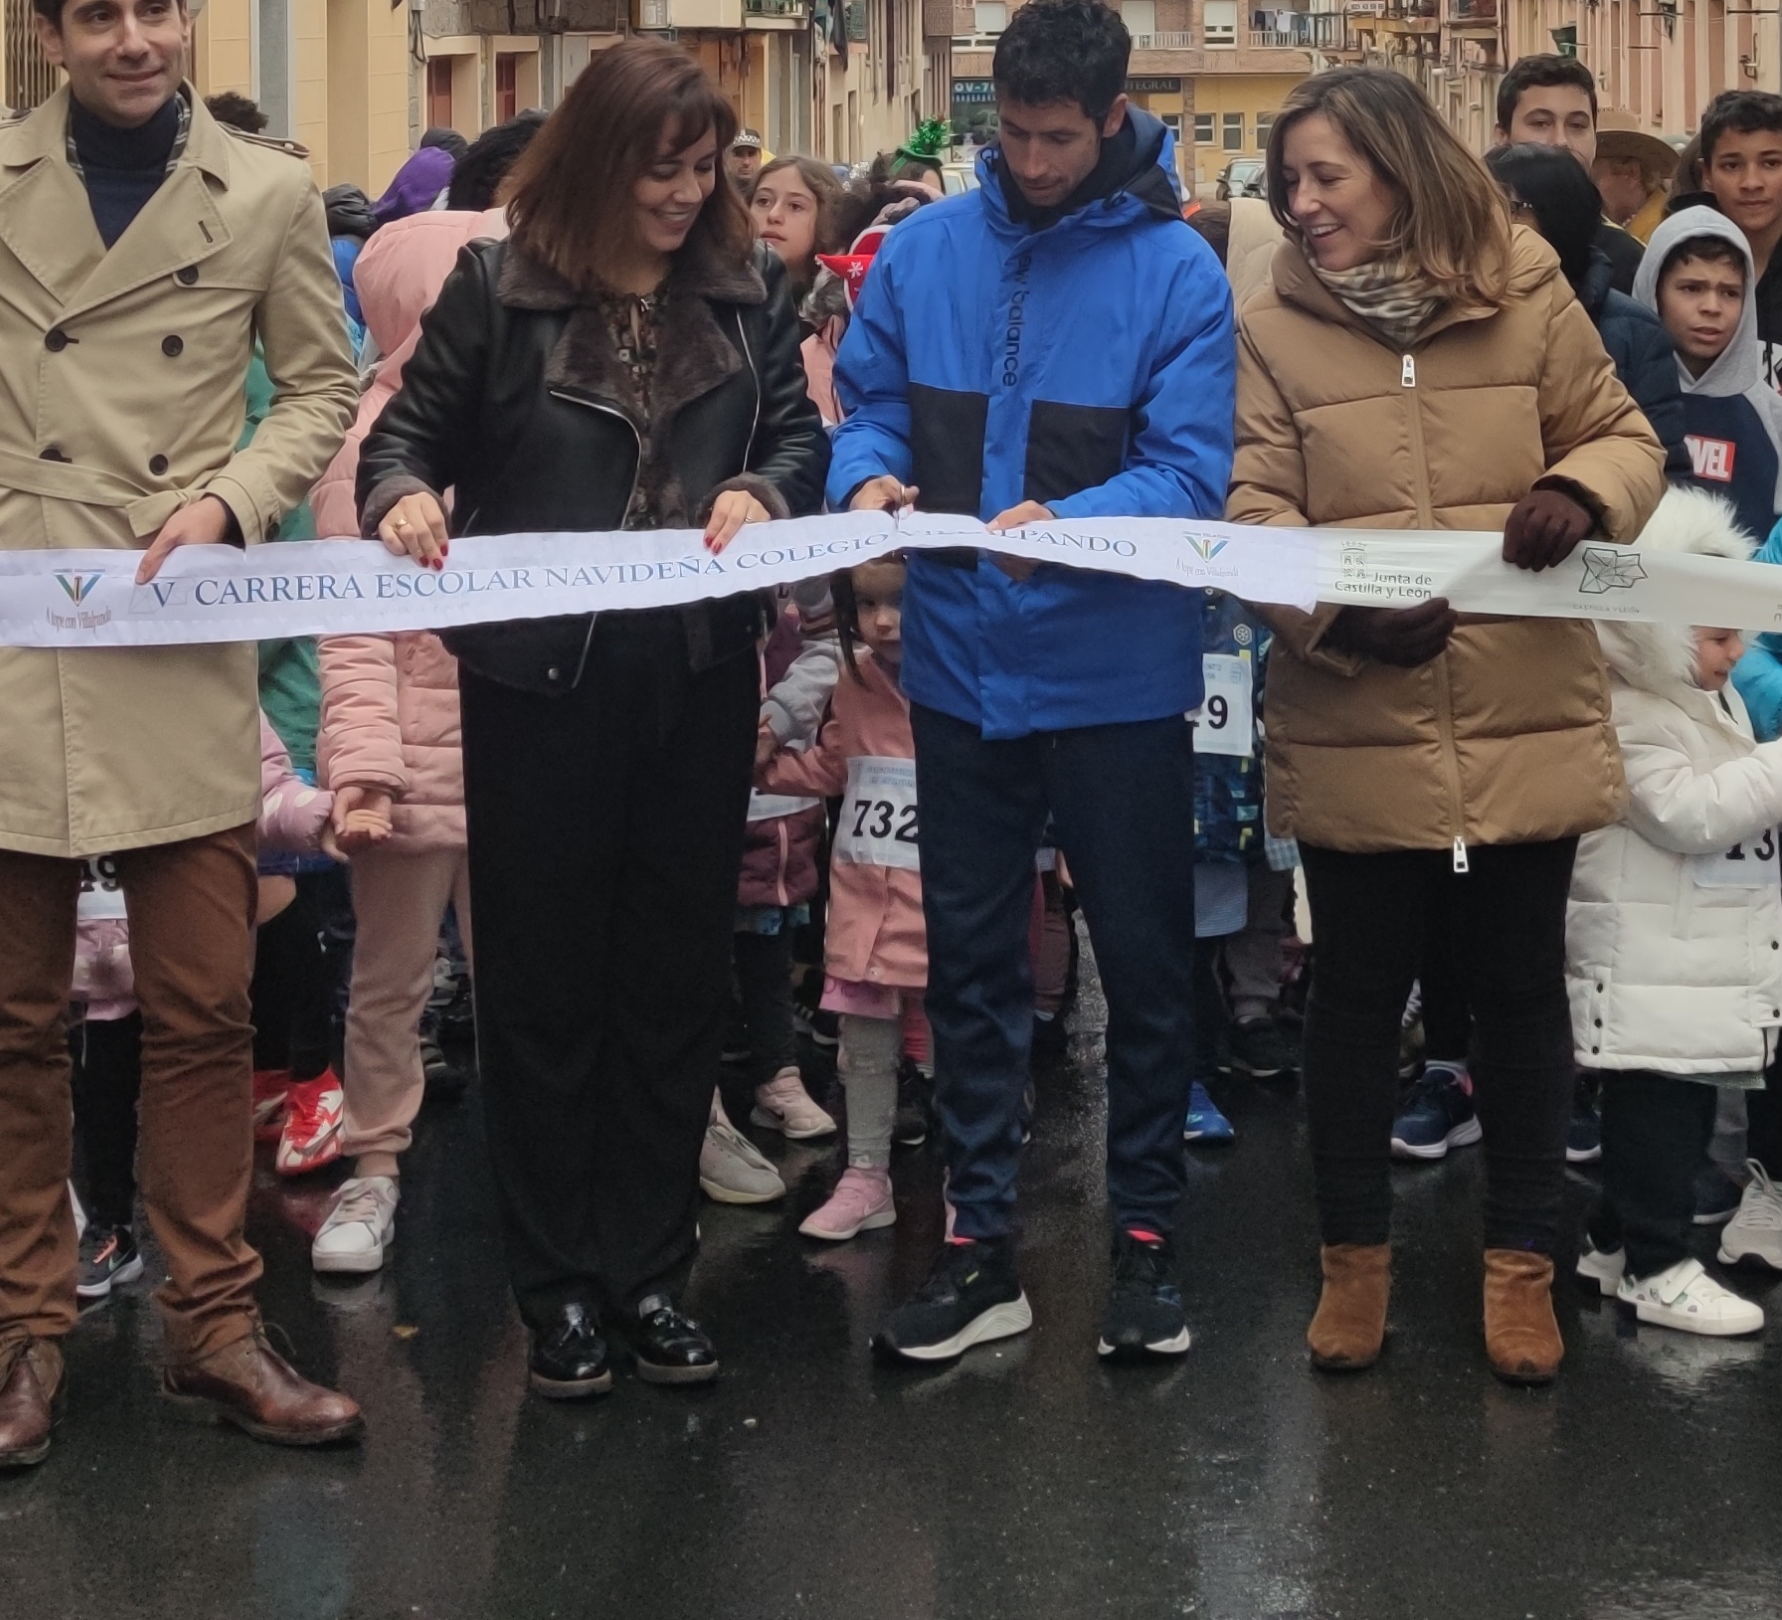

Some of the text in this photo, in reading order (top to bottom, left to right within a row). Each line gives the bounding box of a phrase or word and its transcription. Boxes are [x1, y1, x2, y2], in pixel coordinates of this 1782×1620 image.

[1684, 437, 1729, 478] VEL
[151, 582, 175, 608] V
[195, 574, 364, 607] CARRERA
[376, 567, 532, 599] ESCOLAR
[545, 556, 728, 588] NAVIDEÑA
[737, 532, 890, 569] COLEGIO
[1335, 580, 1382, 595] Castilla
[1386, 586, 1394, 599] y
[1373, 572, 1432, 586] Junta de
[852, 800, 918, 845] 732
